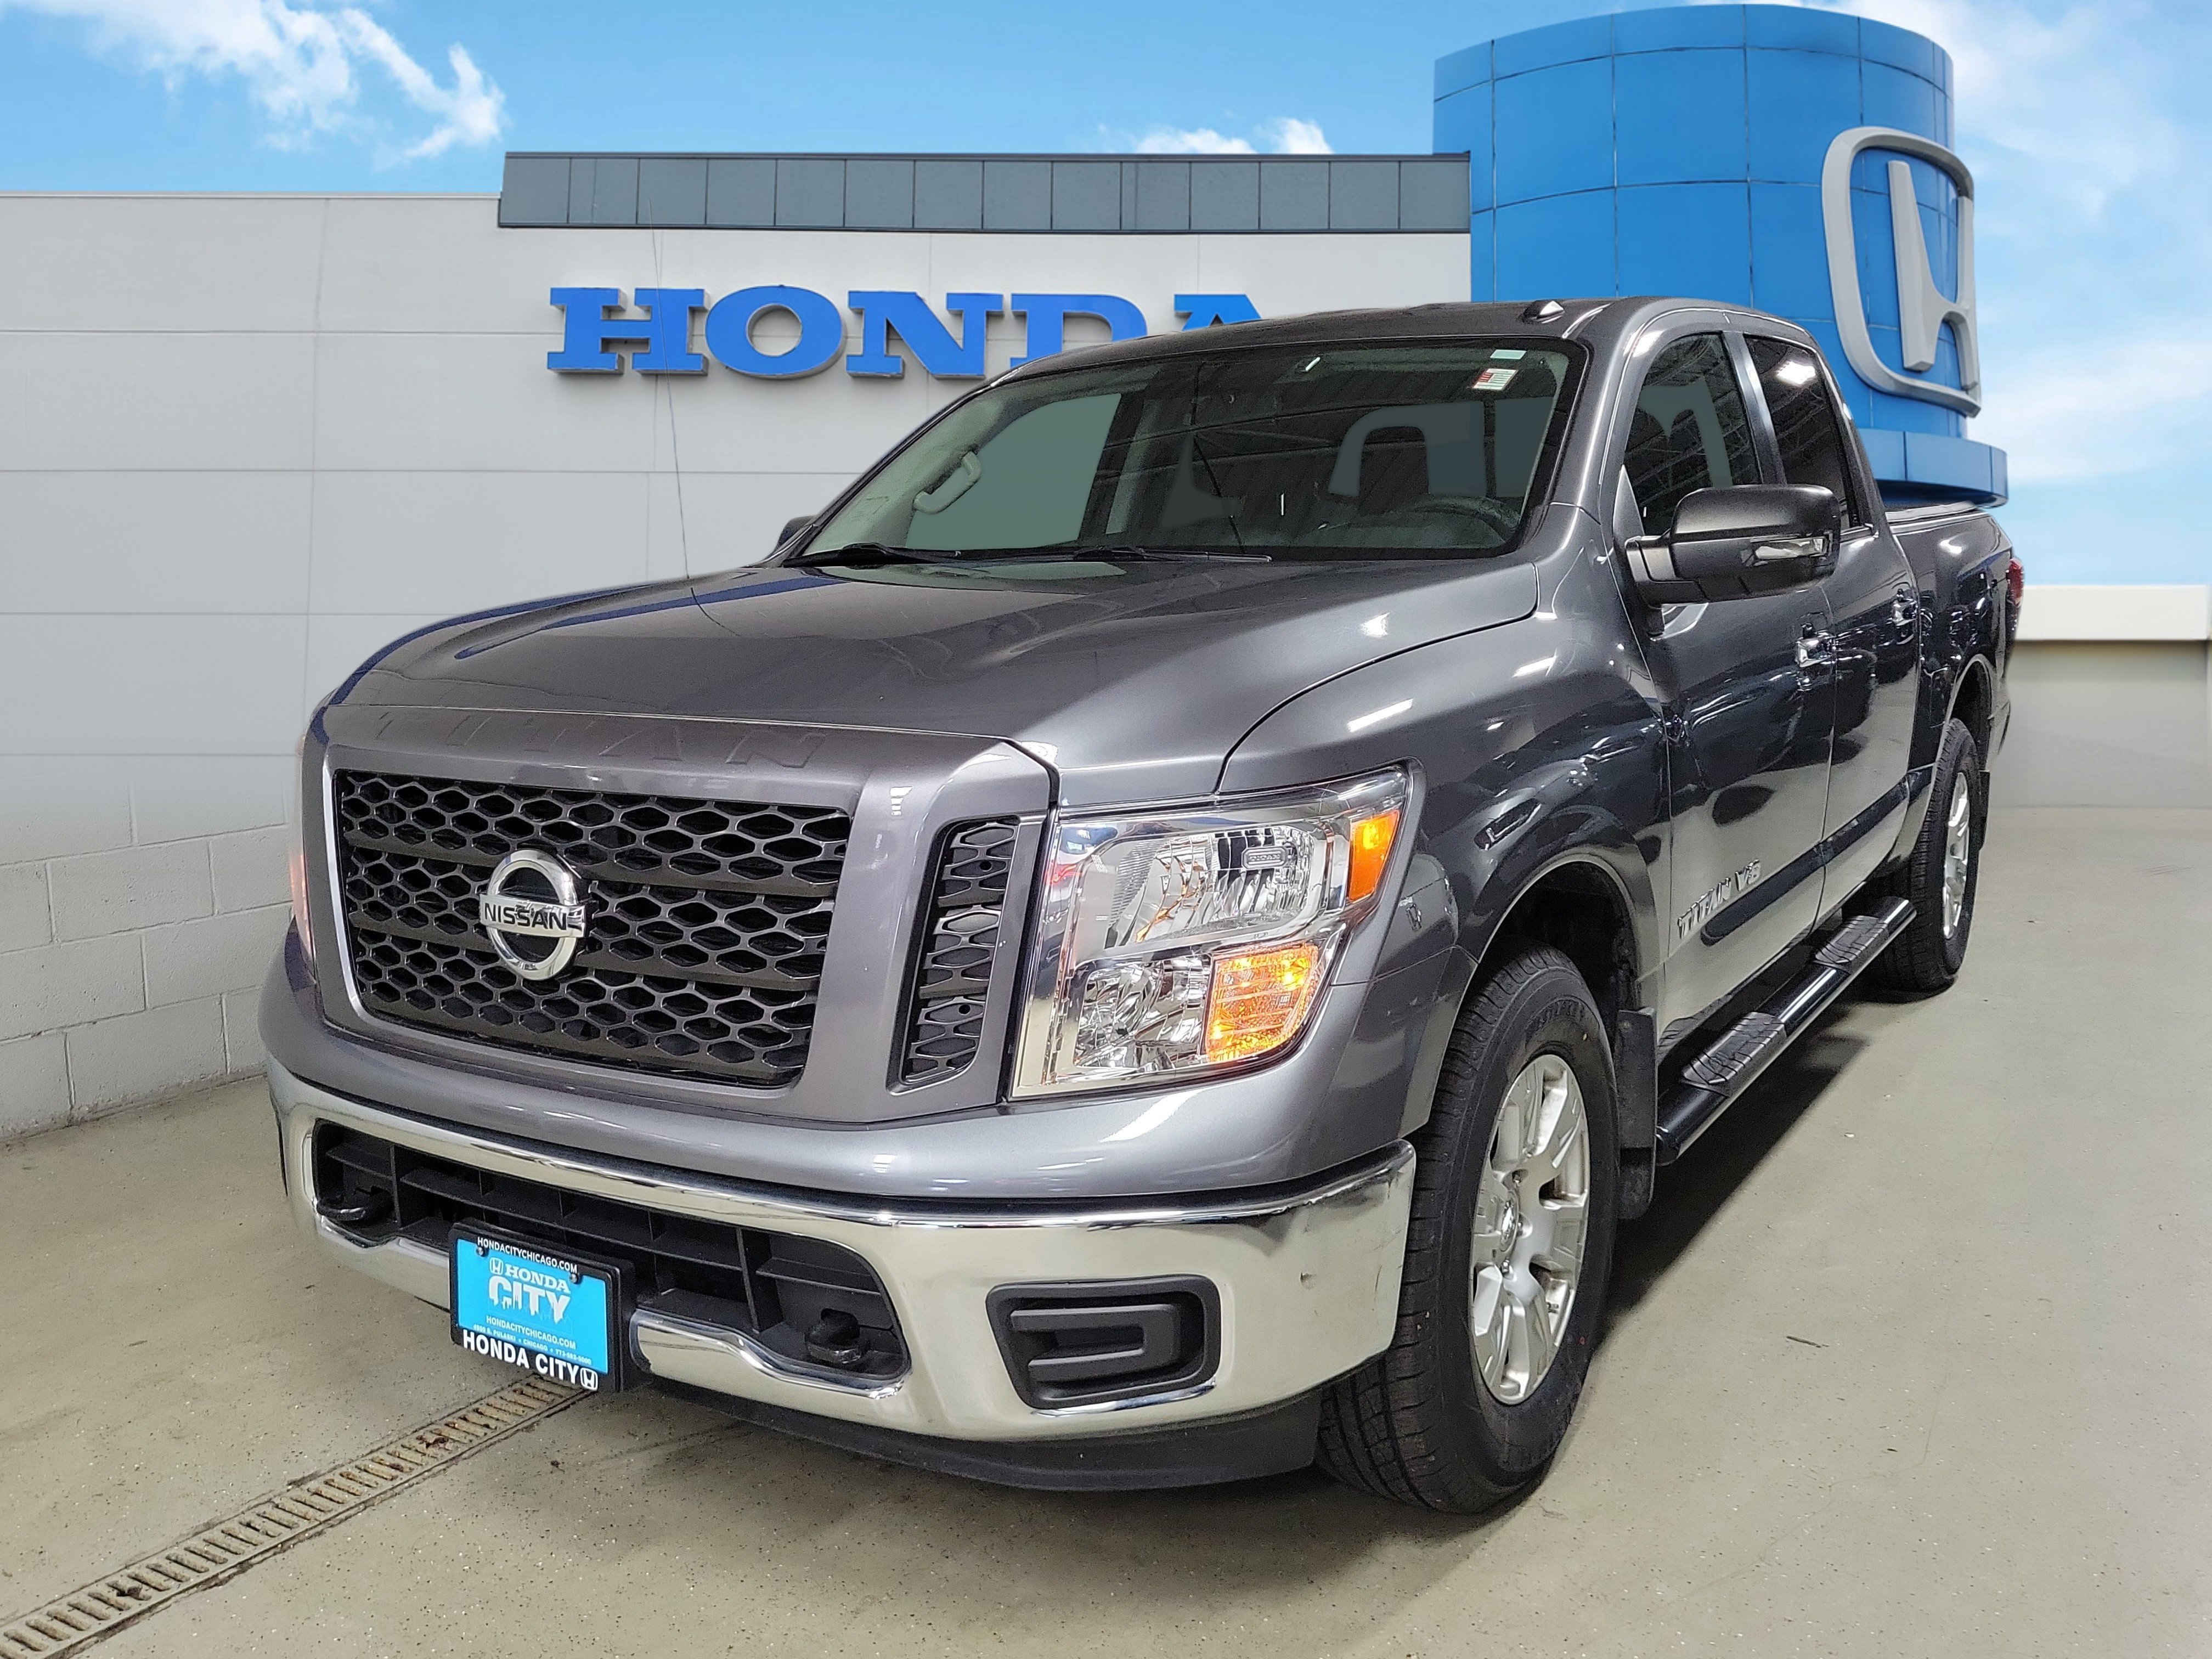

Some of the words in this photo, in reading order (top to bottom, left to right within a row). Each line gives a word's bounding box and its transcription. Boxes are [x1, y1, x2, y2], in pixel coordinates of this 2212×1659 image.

[484, 902, 567, 931] NISSAN
[1677, 877, 1731, 939] TITAN
[1735, 859, 1760, 891] V8
[477, 1237, 577, 1273] HONDACITYCHICAGO.COM
[505, 1263, 571, 1294] HONDA
[488, 1275, 571, 1325] CITY
[486, 1316, 576, 1350] HONDACITYCHICAGO.COM
[493, 1329, 516, 1341] PULASKI
[523, 1339, 548, 1352] CHICAGO
[463, 1329, 529, 1369] HONDA
[535, 1352, 580, 1385] CITY
